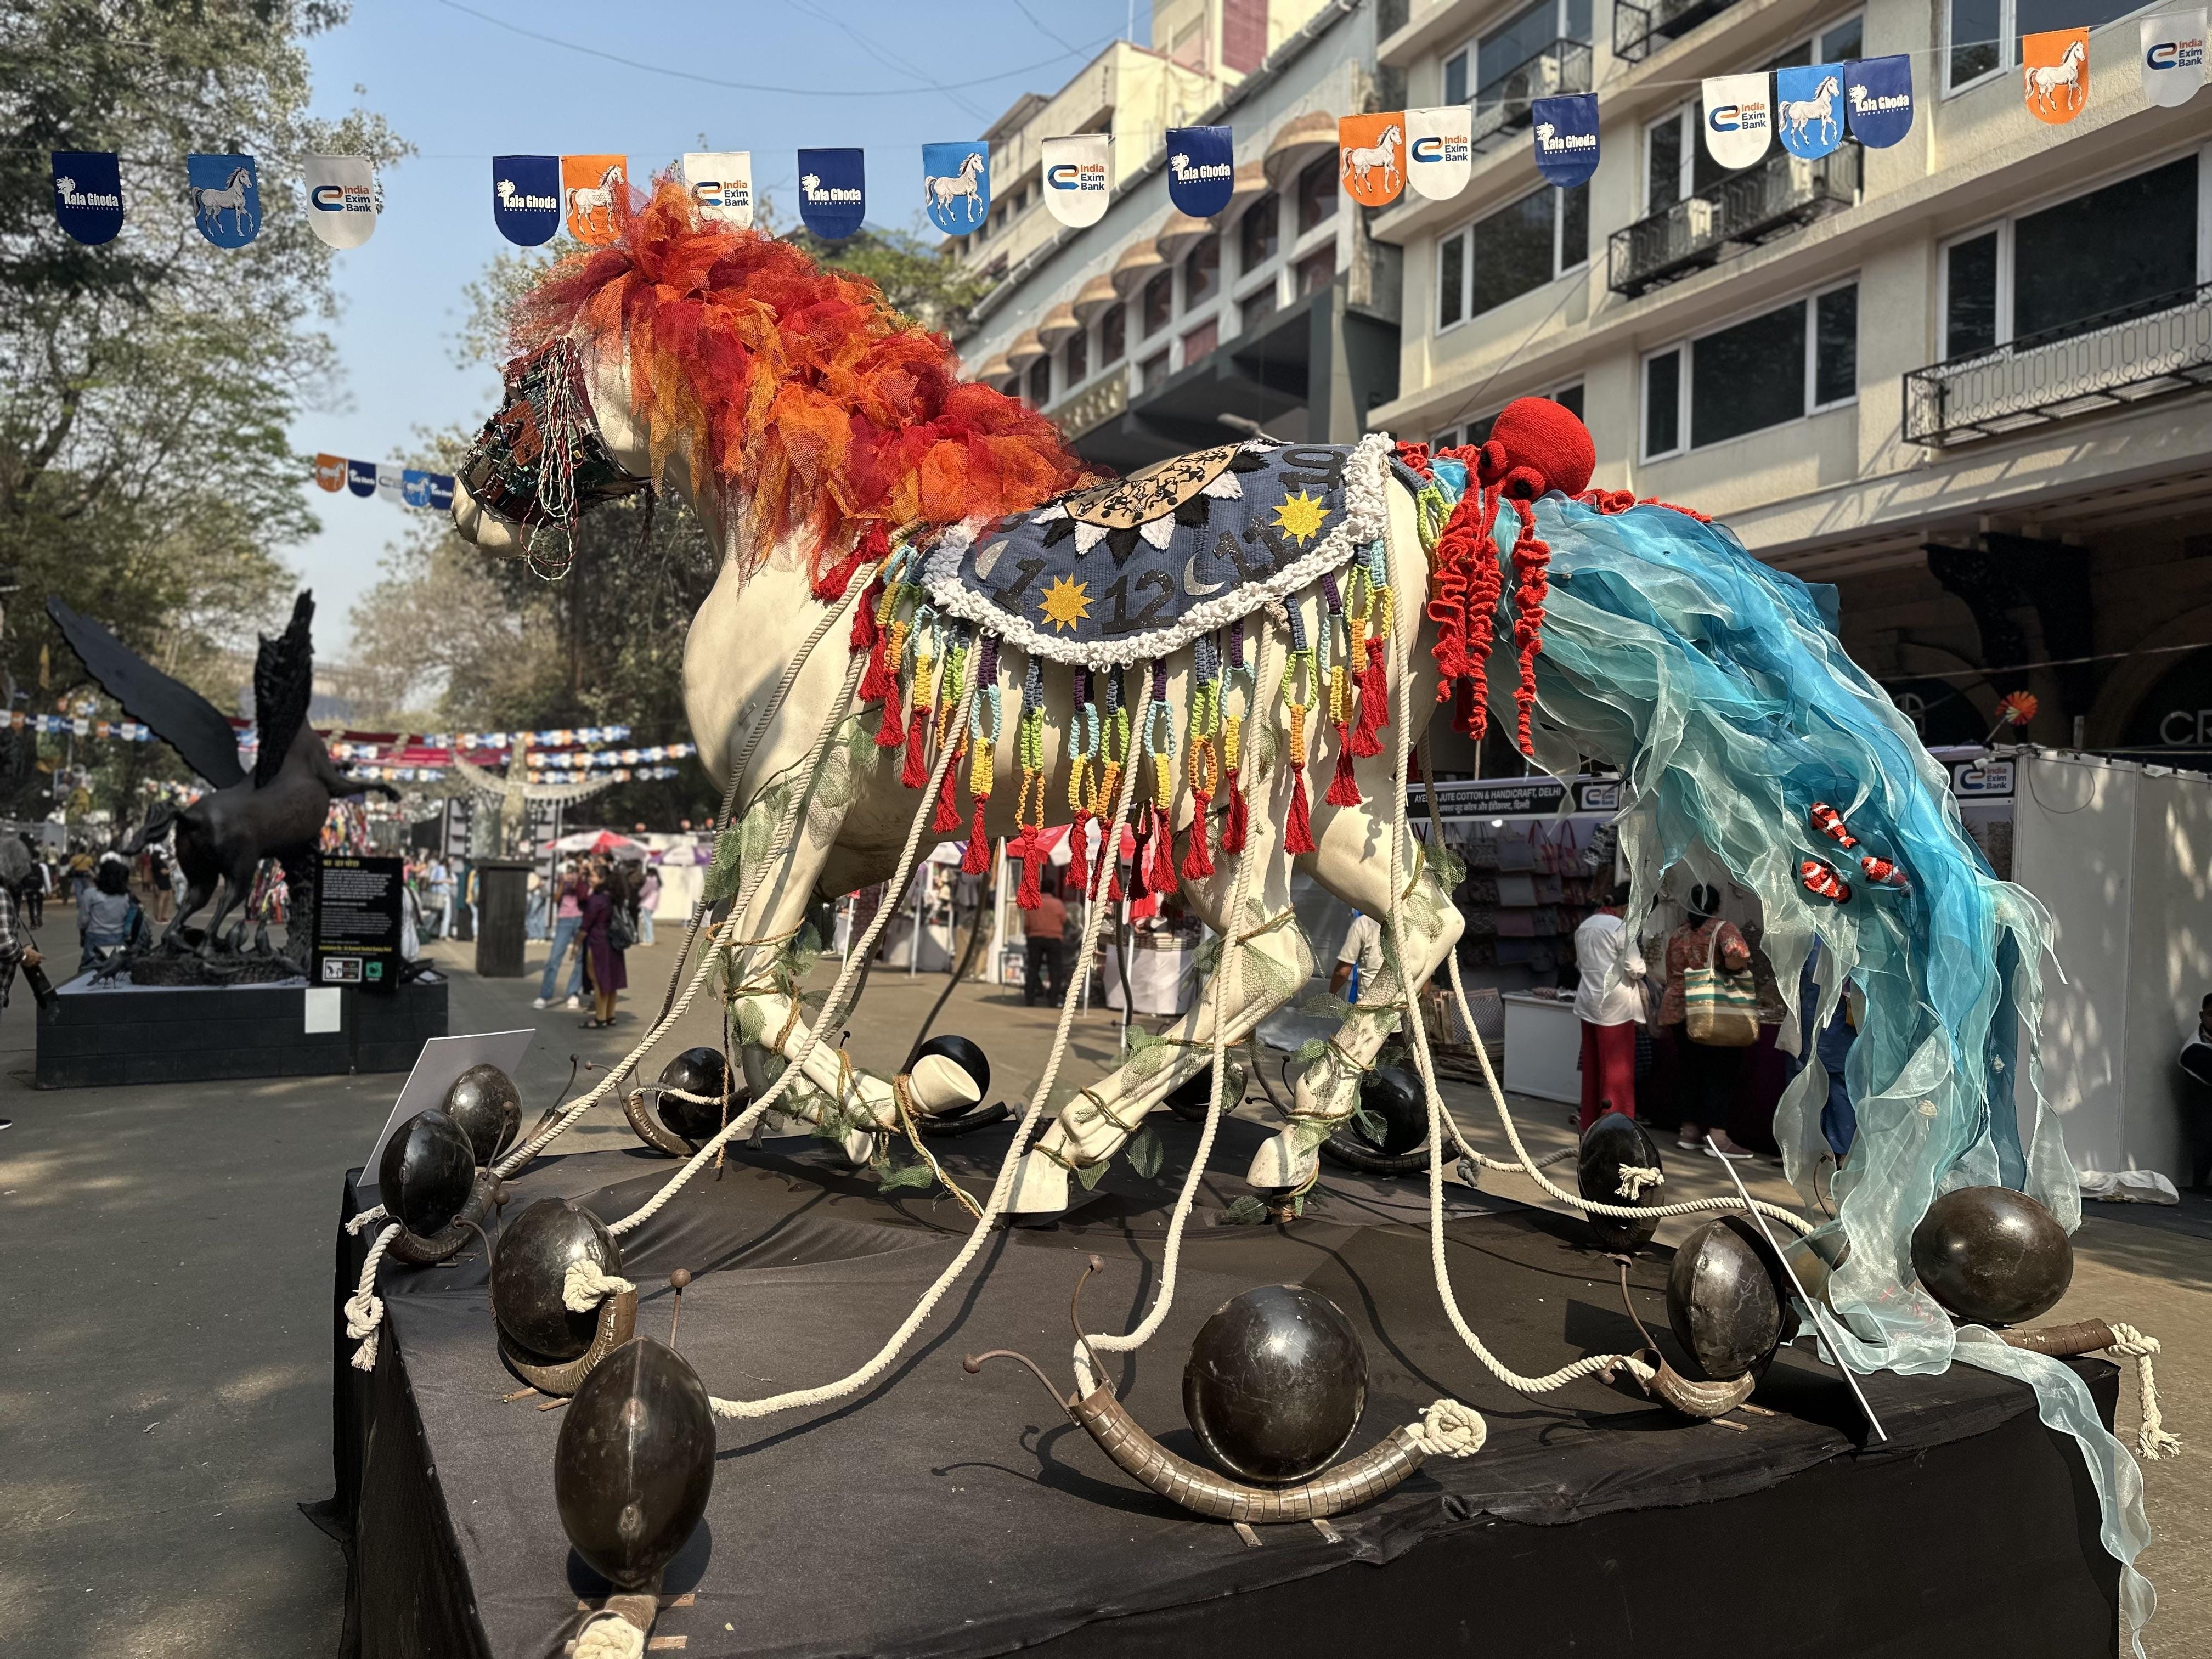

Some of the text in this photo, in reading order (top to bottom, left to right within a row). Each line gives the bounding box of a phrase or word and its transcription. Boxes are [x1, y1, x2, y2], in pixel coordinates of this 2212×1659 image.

[2179, 39, 2203, 48] India
[2179, 49, 2202, 58] Exim
[2179, 58, 2202, 67] Bank
[1741, 102, 1765, 112] India
[1855, 94, 1909, 112] Kala Ghoda
[1742, 112, 1765, 121] Exim
[1742, 121, 1767, 129] Bank
[1444, 135, 1468, 144] India
[1543, 133, 1596, 151] Kala Ghoda
[1445, 144, 1468, 153] Exim
[1445, 154, 1468, 162] Bank
[1081, 164, 1104, 172] India
[1177, 163, 1231, 180] Kala Ghoda
[724, 180, 748, 189] India
[1081, 182, 1104, 190] Bank
[344, 185, 369, 194] India
[724, 189, 748, 198] Exim
[345, 195, 370, 203] Exim
[808, 188, 861, 201] Kala Ghoda
[64, 193, 119, 207] Kala Ghoda
[503, 195, 557, 208] Kala Ghoda
[725, 198, 749, 206] Bank
[346, 204, 371, 212] Bank
[1278, 448, 1346, 493] 10
[1213, 515, 1301, 589] 11
[992, 558, 1047, 616] 1
[1102, 568, 1178, 633] 12
[1414, 787, 1561, 803] AYEA JUTE COTTON & HANDICRAFT, DELHI
